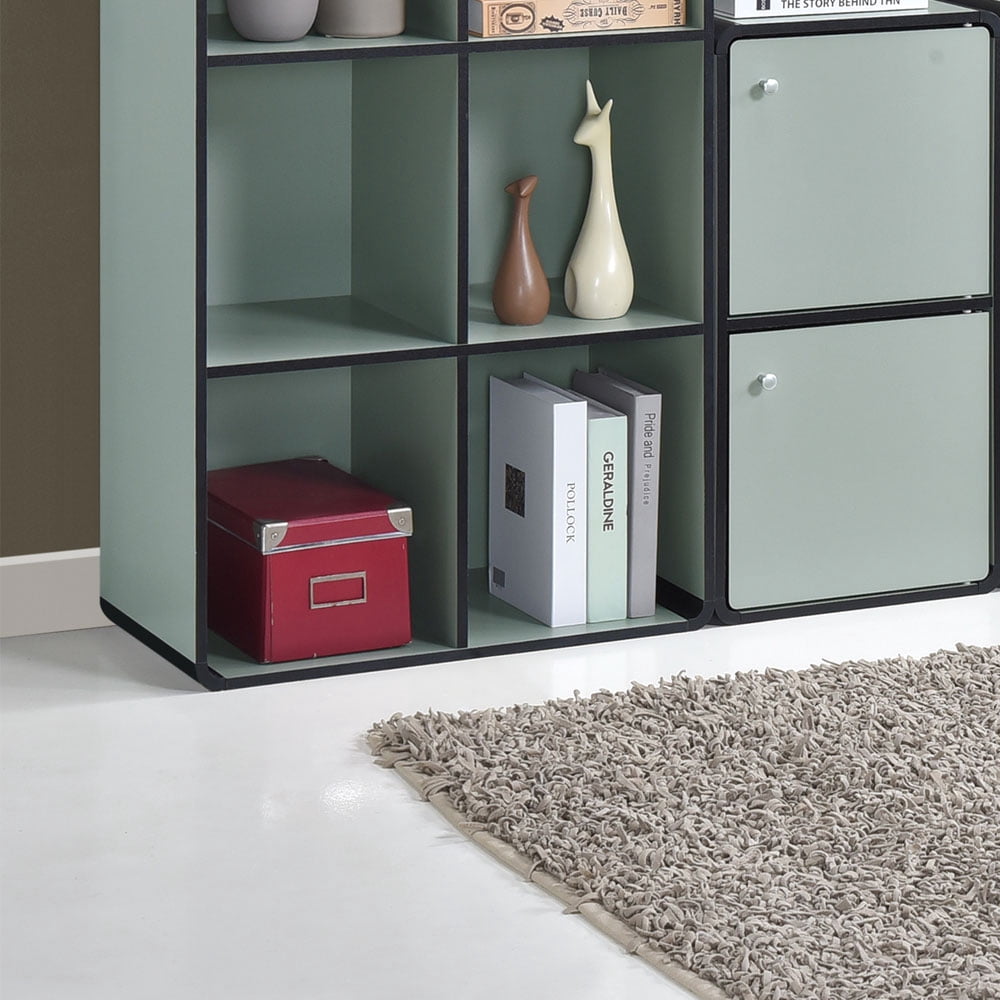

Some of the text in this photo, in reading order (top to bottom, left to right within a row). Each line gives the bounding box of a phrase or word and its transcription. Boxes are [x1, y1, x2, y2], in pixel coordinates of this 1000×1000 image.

[580, 6, 628, 18] DAILY CURSE
[781, 0, 801, 9] THE
[643, 412, 656, 505] Pride and Prejudice
[566, 482, 576, 544] POLLOCK
[603, 451, 614, 532] GERALDINE
